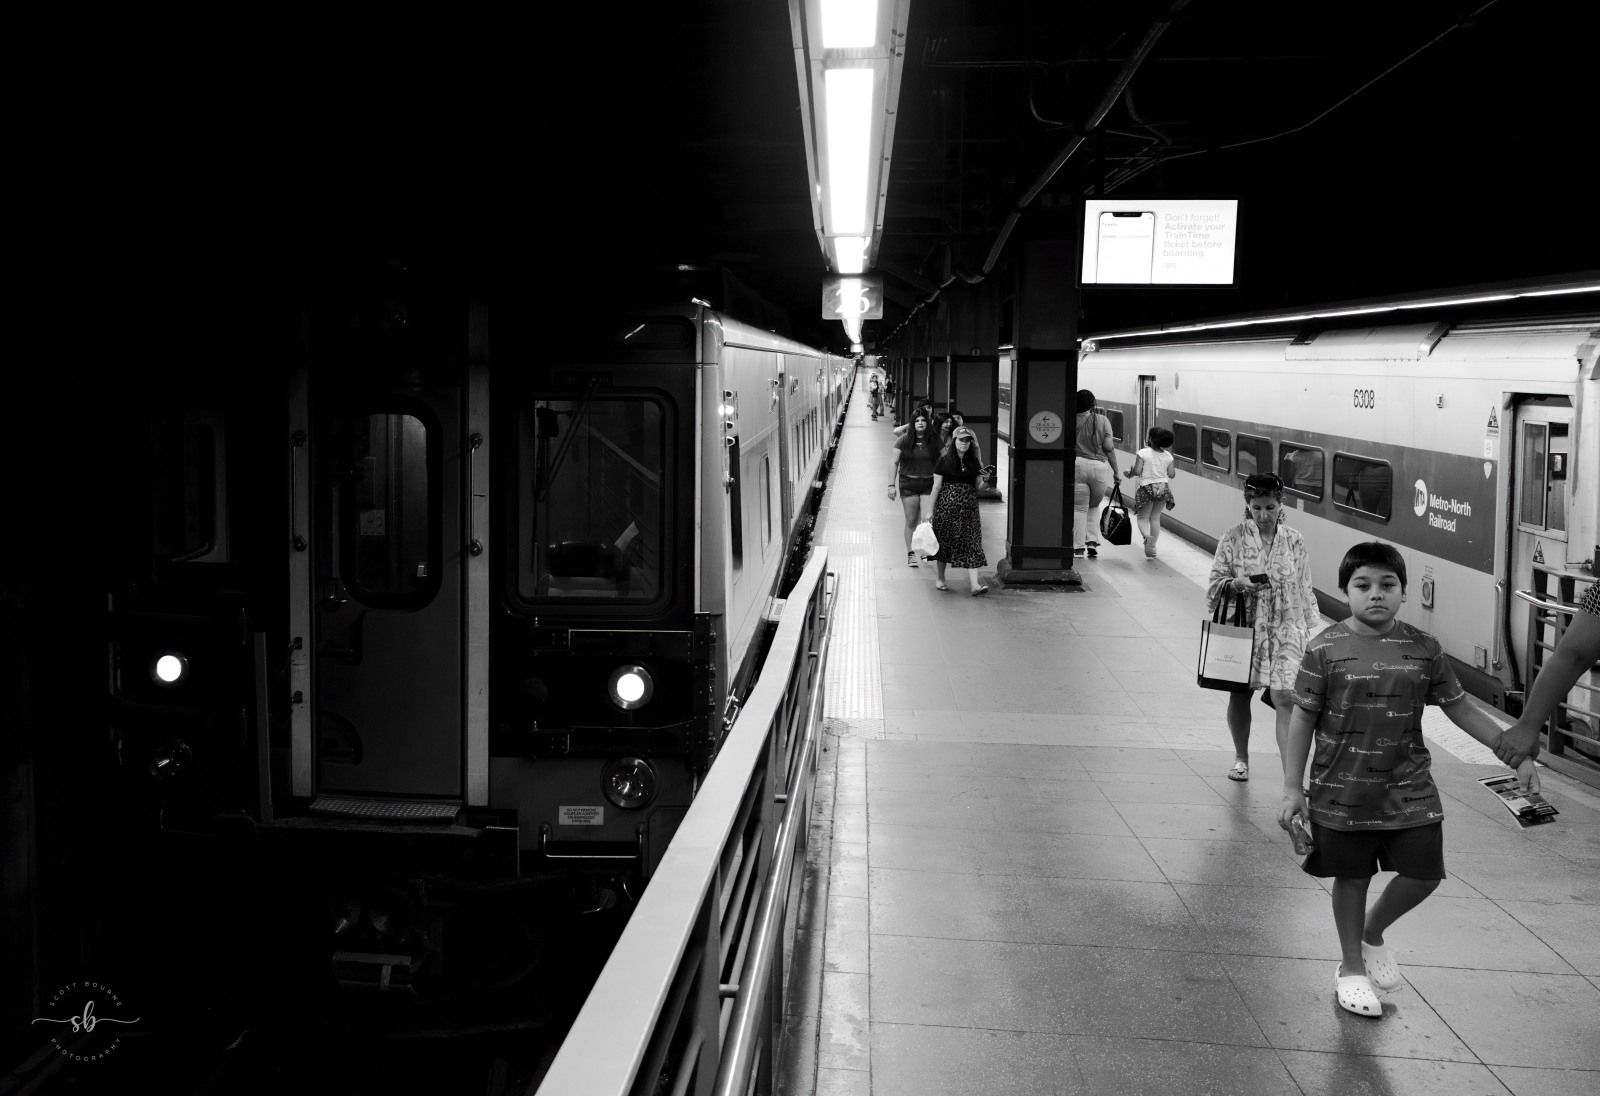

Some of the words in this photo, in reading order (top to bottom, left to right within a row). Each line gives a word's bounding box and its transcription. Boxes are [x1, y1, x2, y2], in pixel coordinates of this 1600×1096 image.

[1165, 213, 1188, 222] Don't
[1190, 213, 1220, 224] forget!
[1164, 222, 1203, 231] Activate
[1204, 224, 1226, 233] your
[1165, 231, 1210, 240] TrainTime
[1163, 240, 1190, 248] ticket
[1191, 240, 1223, 248] before
[1163, 249, 1207, 259] boarding.
[1085, 343, 1096, 352] 25
[1353, 388, 1375, 410] 6308
[1429, 494, 1472, 517] Metro-North
[1429, 512, 1456, 533] Railroad
[1344, 673, 1381, 681] Champion
[1348, 746, 1384, 756] Champion
